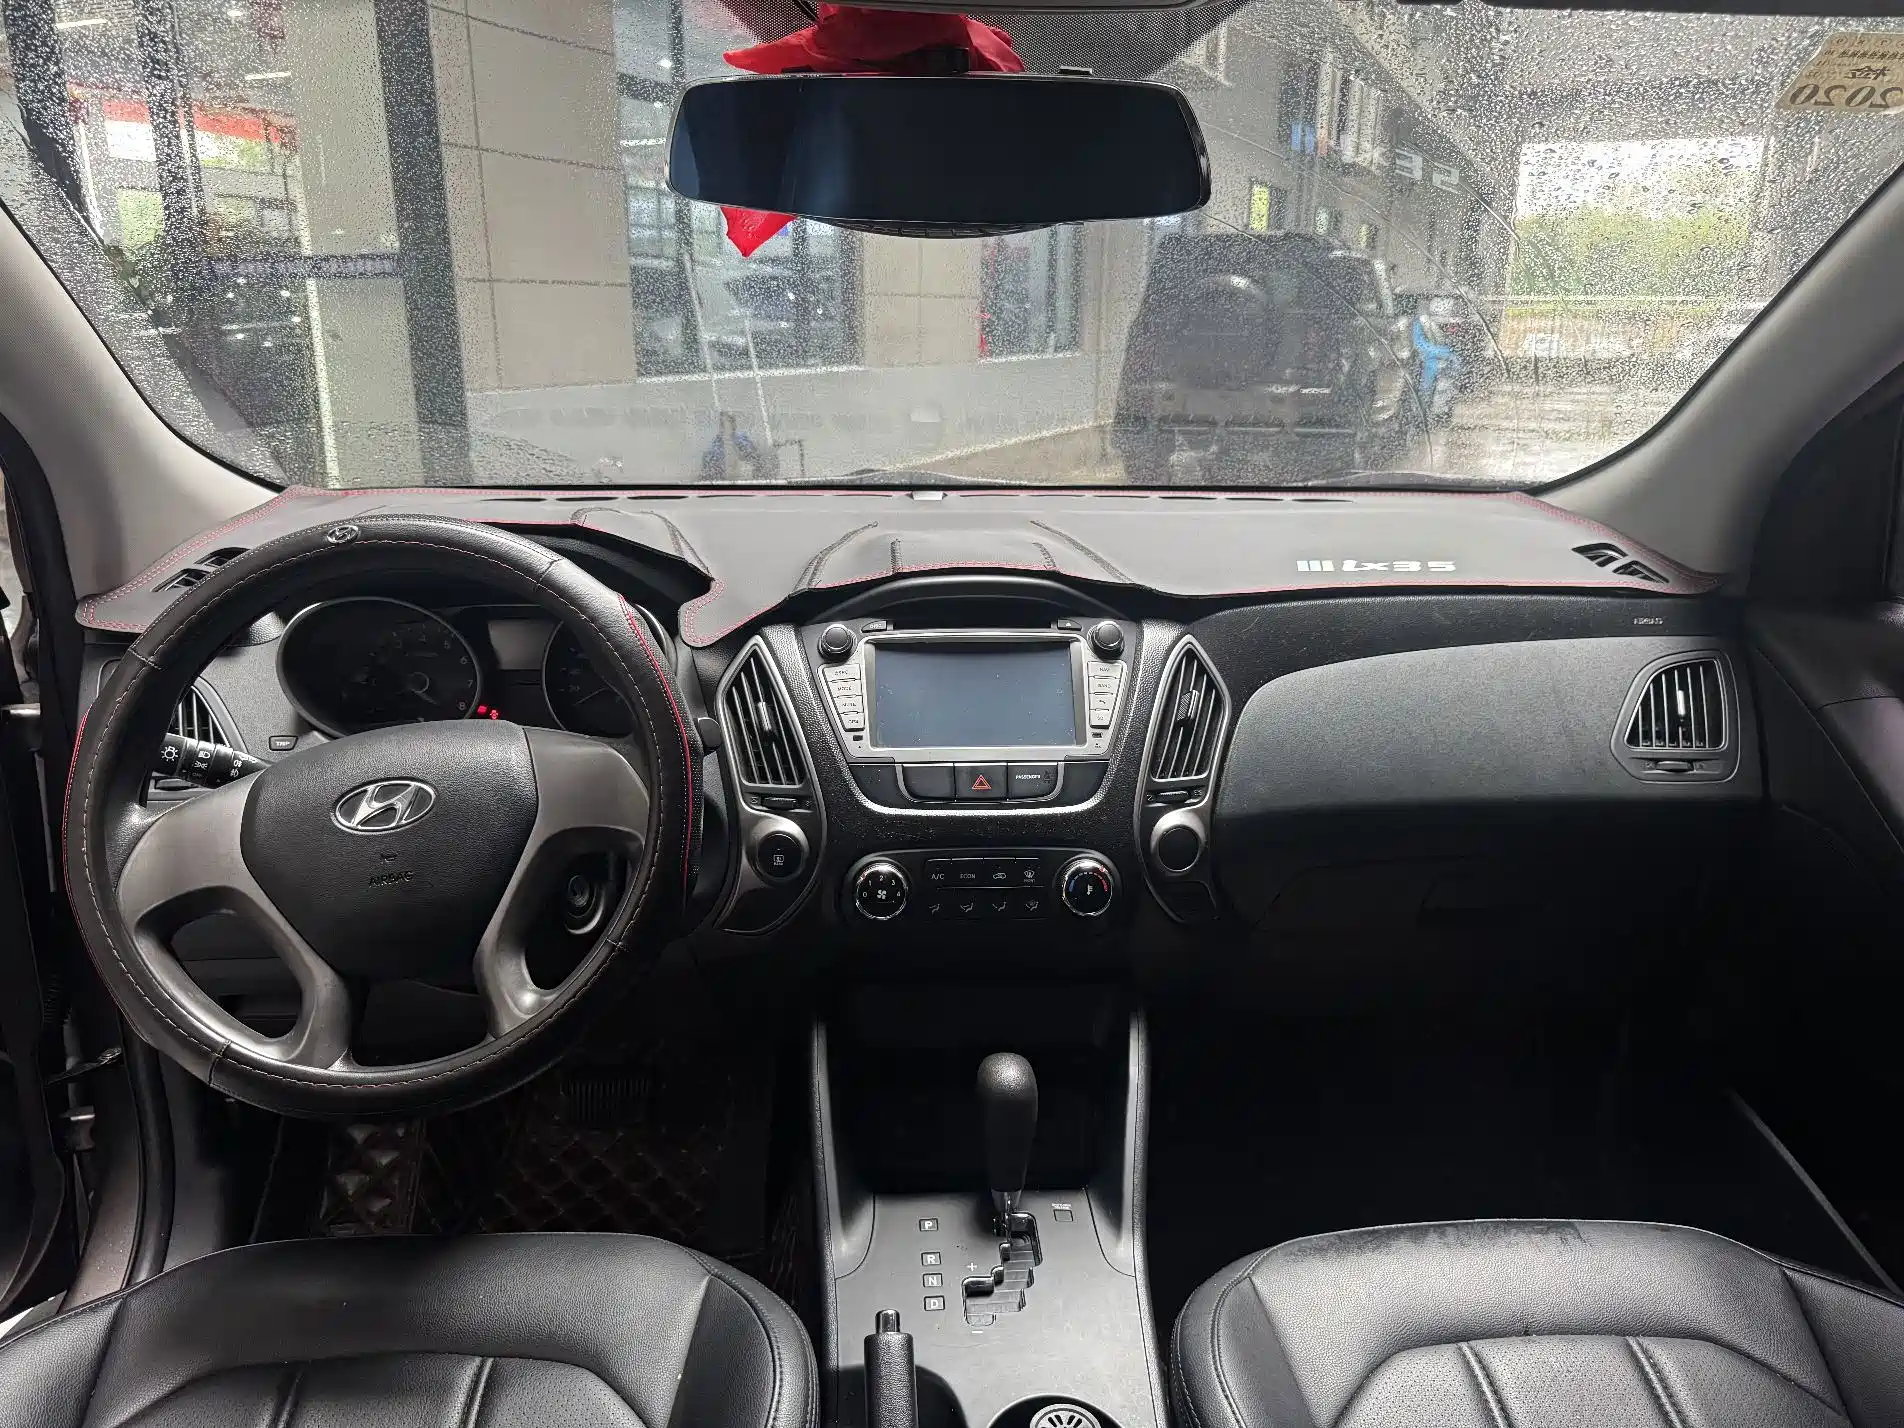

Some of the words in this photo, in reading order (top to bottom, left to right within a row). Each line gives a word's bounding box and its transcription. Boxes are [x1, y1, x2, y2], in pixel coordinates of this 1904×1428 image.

[931, 872, 945, 880] A/C
[924, 1221, 933, 1230] P
[927, 1254, 936, 1264] R
[928, 1276, 938, 1286] N
[930, 1299, 939, 1310] D
